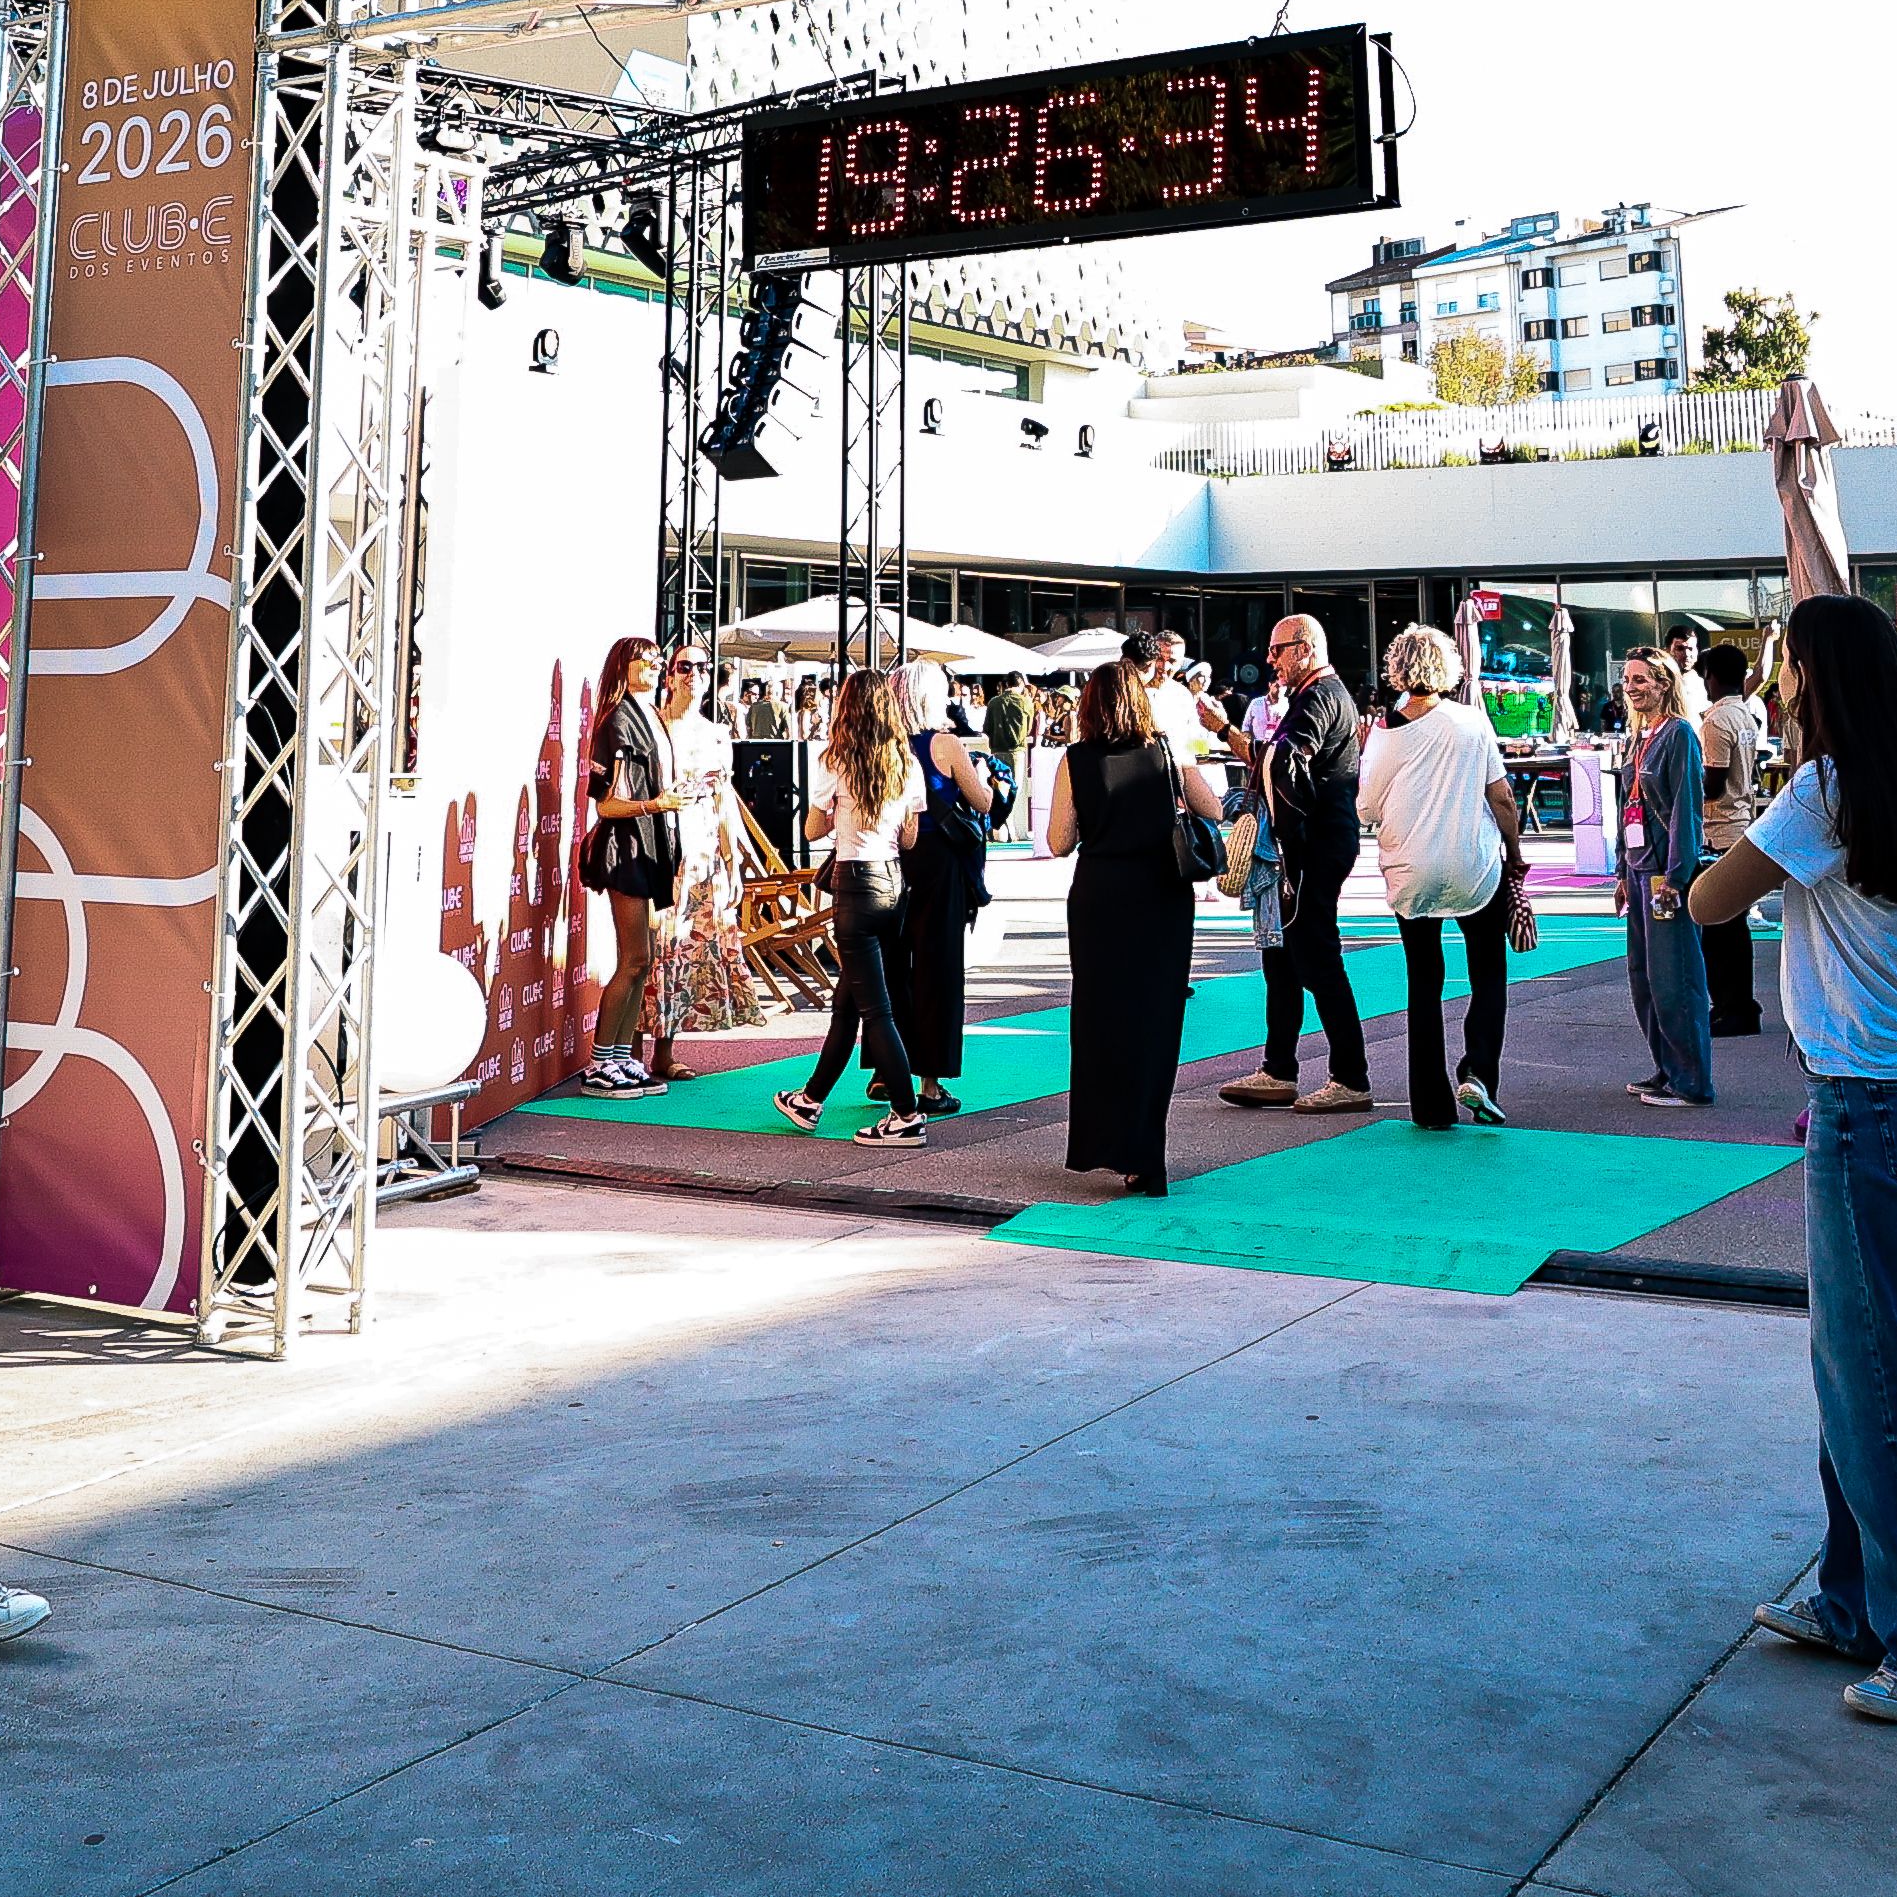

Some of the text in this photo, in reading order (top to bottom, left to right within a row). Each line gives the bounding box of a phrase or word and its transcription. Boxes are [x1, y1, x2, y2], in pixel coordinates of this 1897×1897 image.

[81, 59, 235, 110] 8 DE JULHO
[77, 103, 233, 186] 2026
[68, 247, 231, 280] DOS EVENTOS
